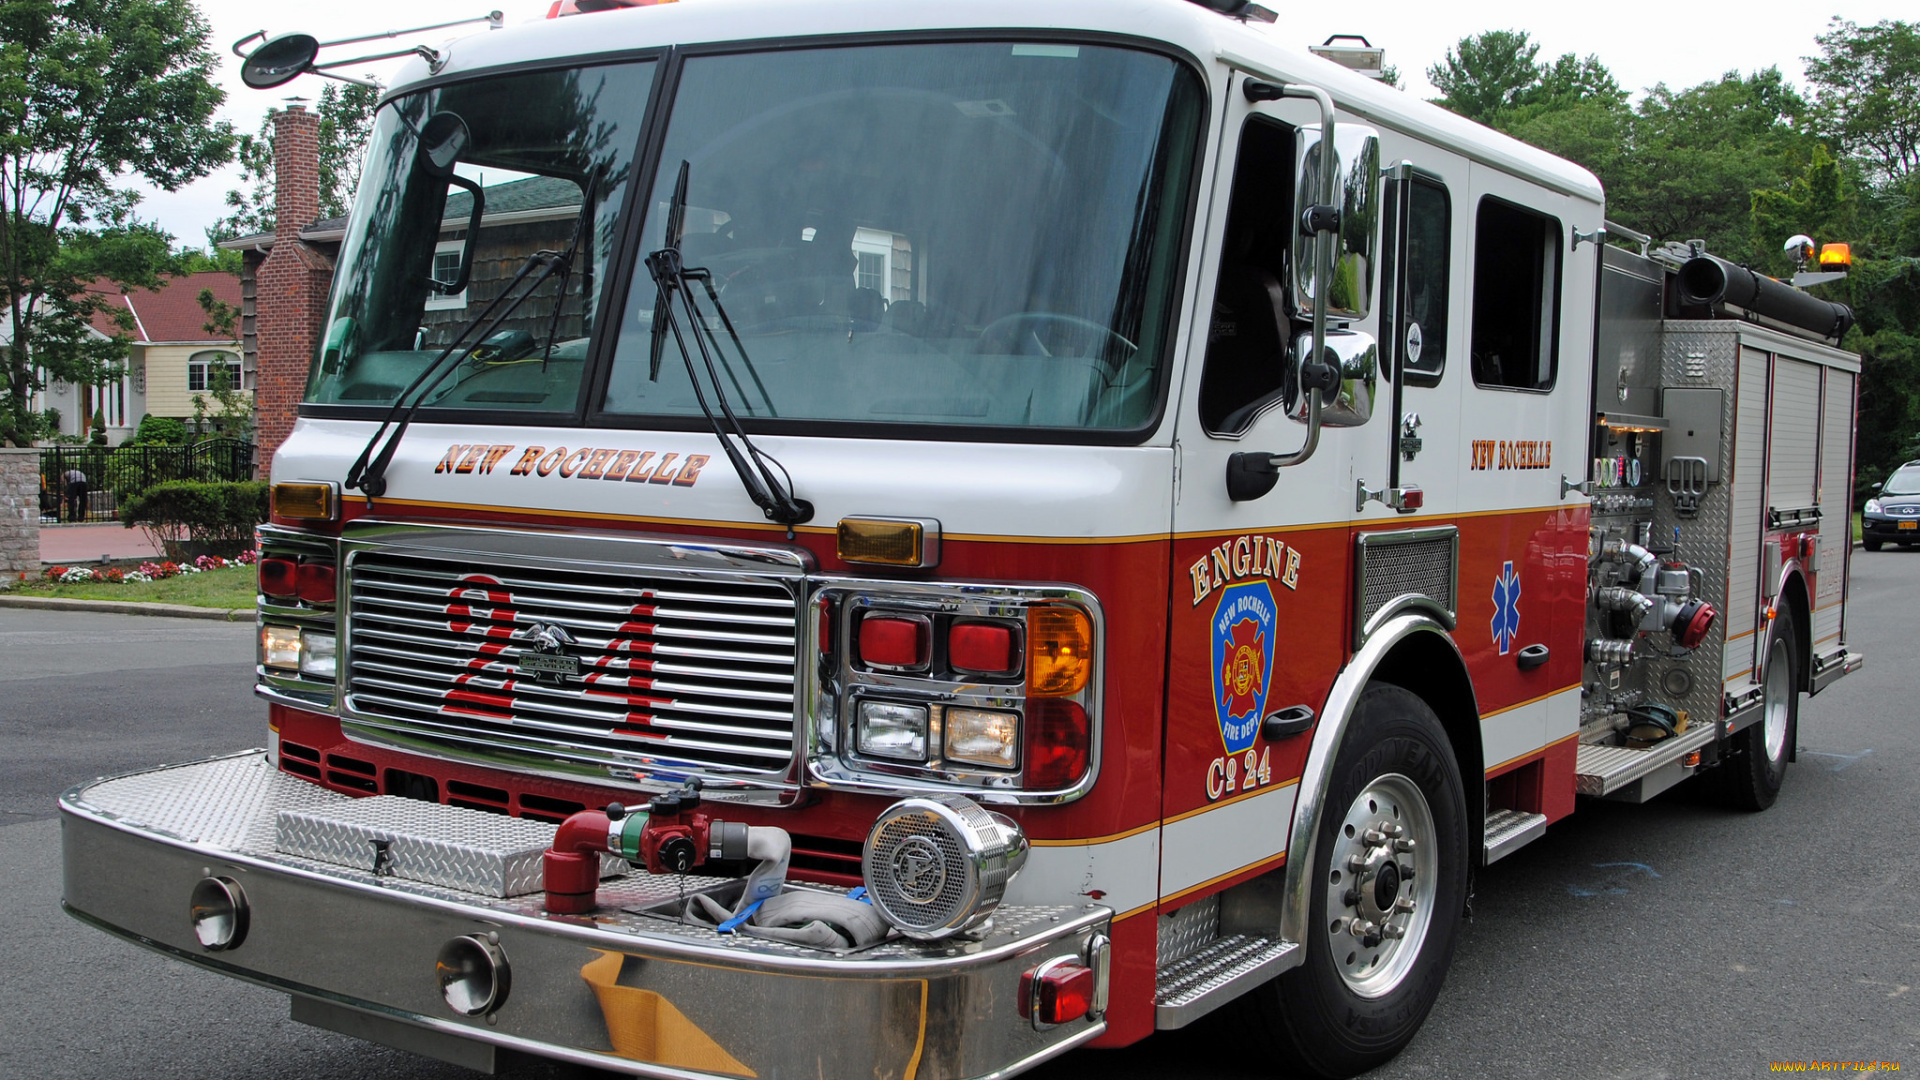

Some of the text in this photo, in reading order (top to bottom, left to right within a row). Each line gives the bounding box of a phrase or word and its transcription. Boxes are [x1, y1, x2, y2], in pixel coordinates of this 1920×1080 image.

[434, 444, 711, 488] NEW ROCHELLE
[1471, 439, 1551, 471] NEW ROCHELLE
[1189, 535, 1301, 607] ENGINE
[1219, 595, 1270, 635] NEW ROCHELLE
[1223, 712, 1259, 741] FIRE DEPT
[1242, 745, 1271, 790] 24
